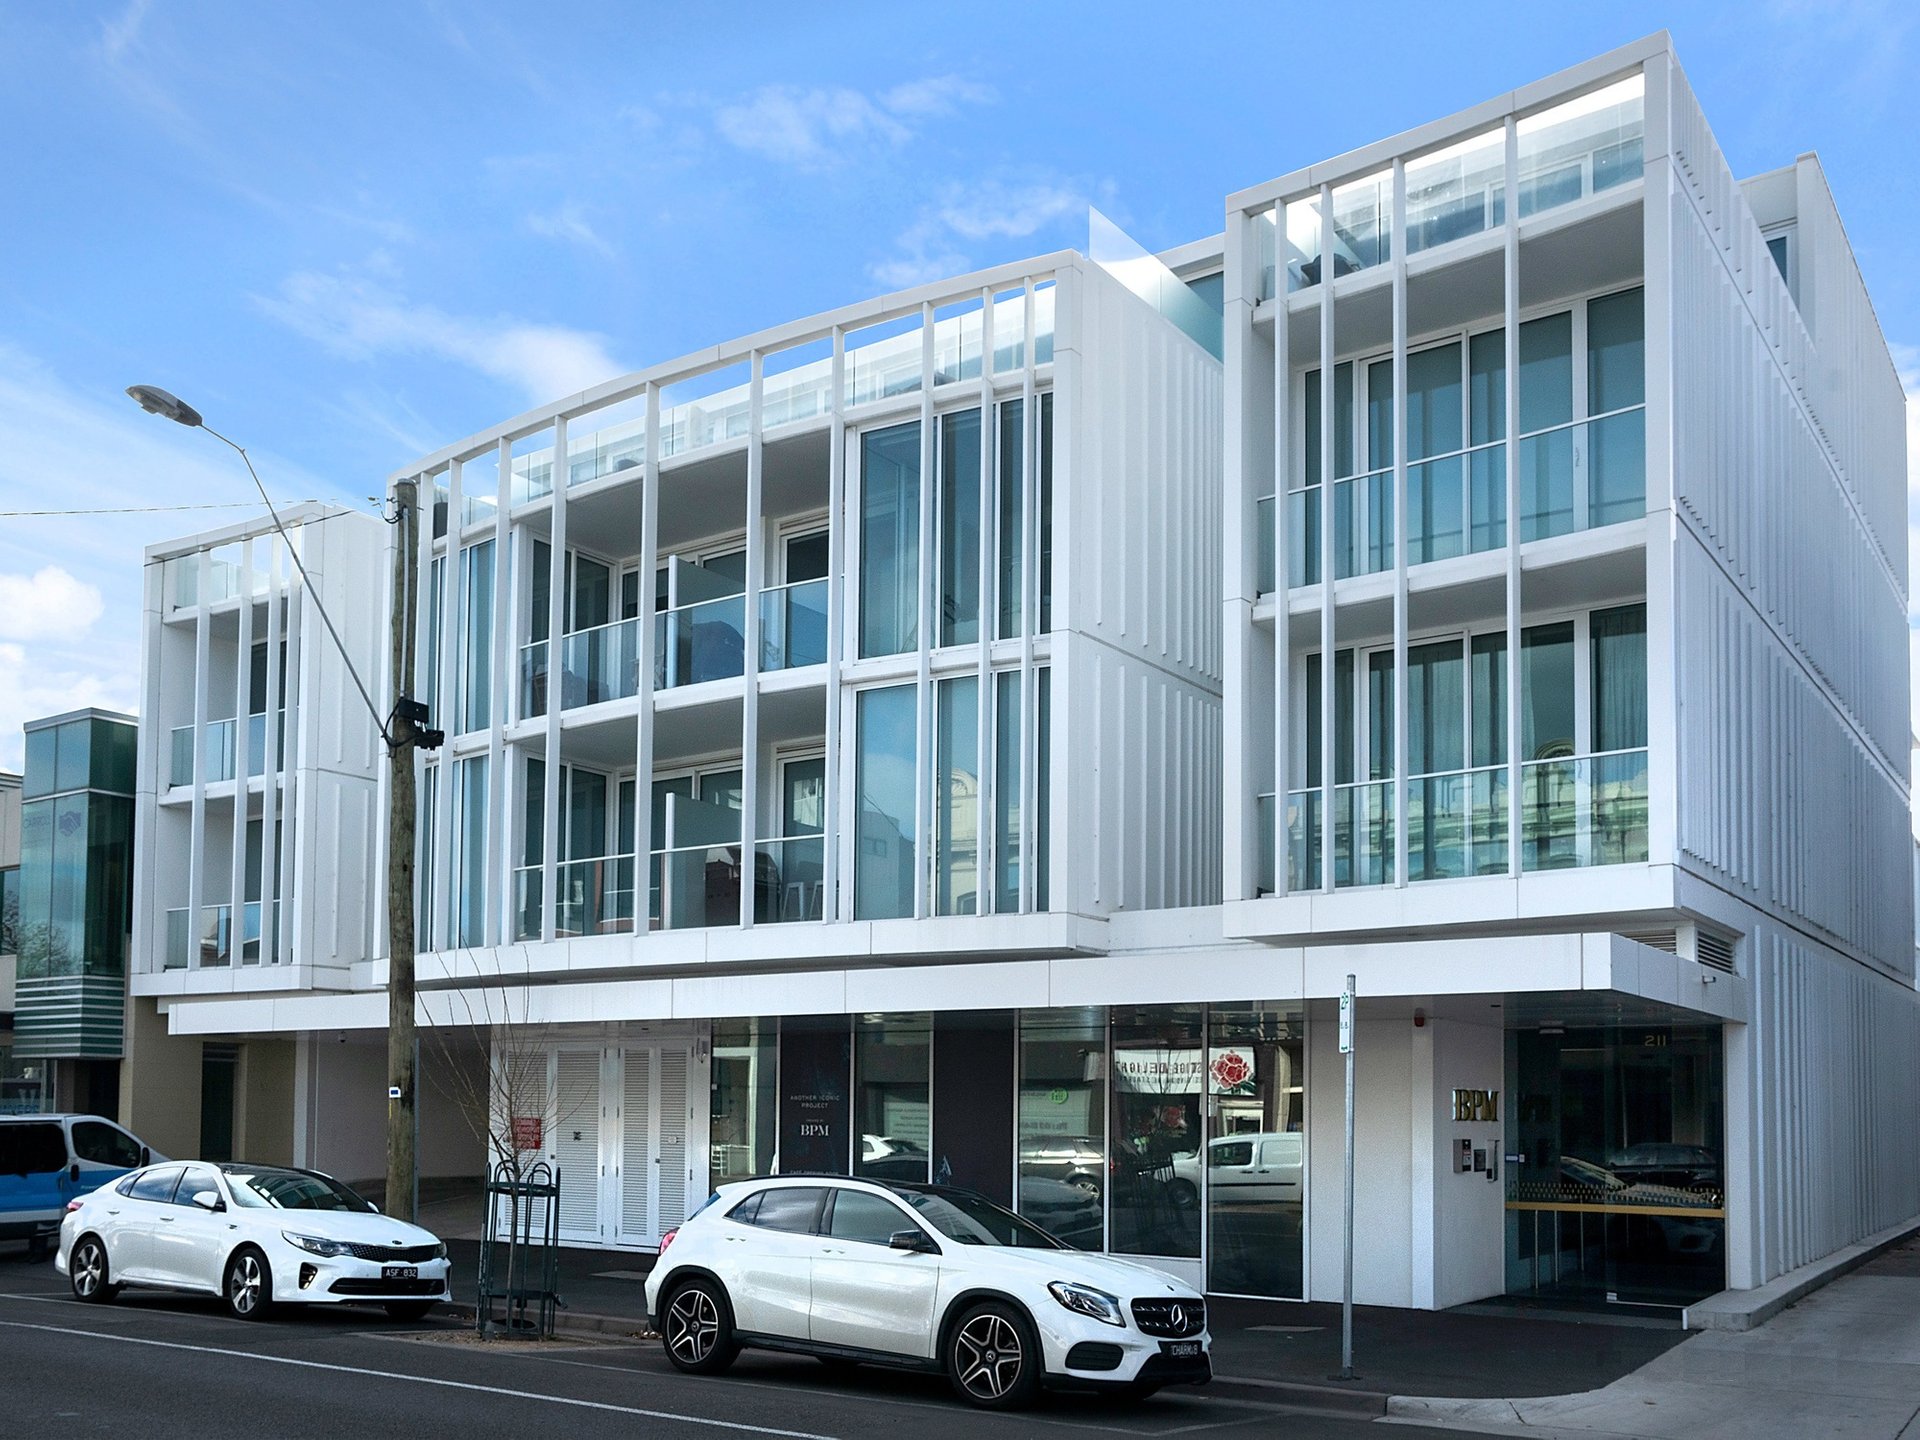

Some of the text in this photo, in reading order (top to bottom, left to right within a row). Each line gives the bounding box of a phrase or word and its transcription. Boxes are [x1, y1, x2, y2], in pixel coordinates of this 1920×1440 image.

[1644, 1034, 1667, 1047] 211
[1452, 1088, 1499, 1121] BPM
[800, 1124, 830, 1137] BPM
